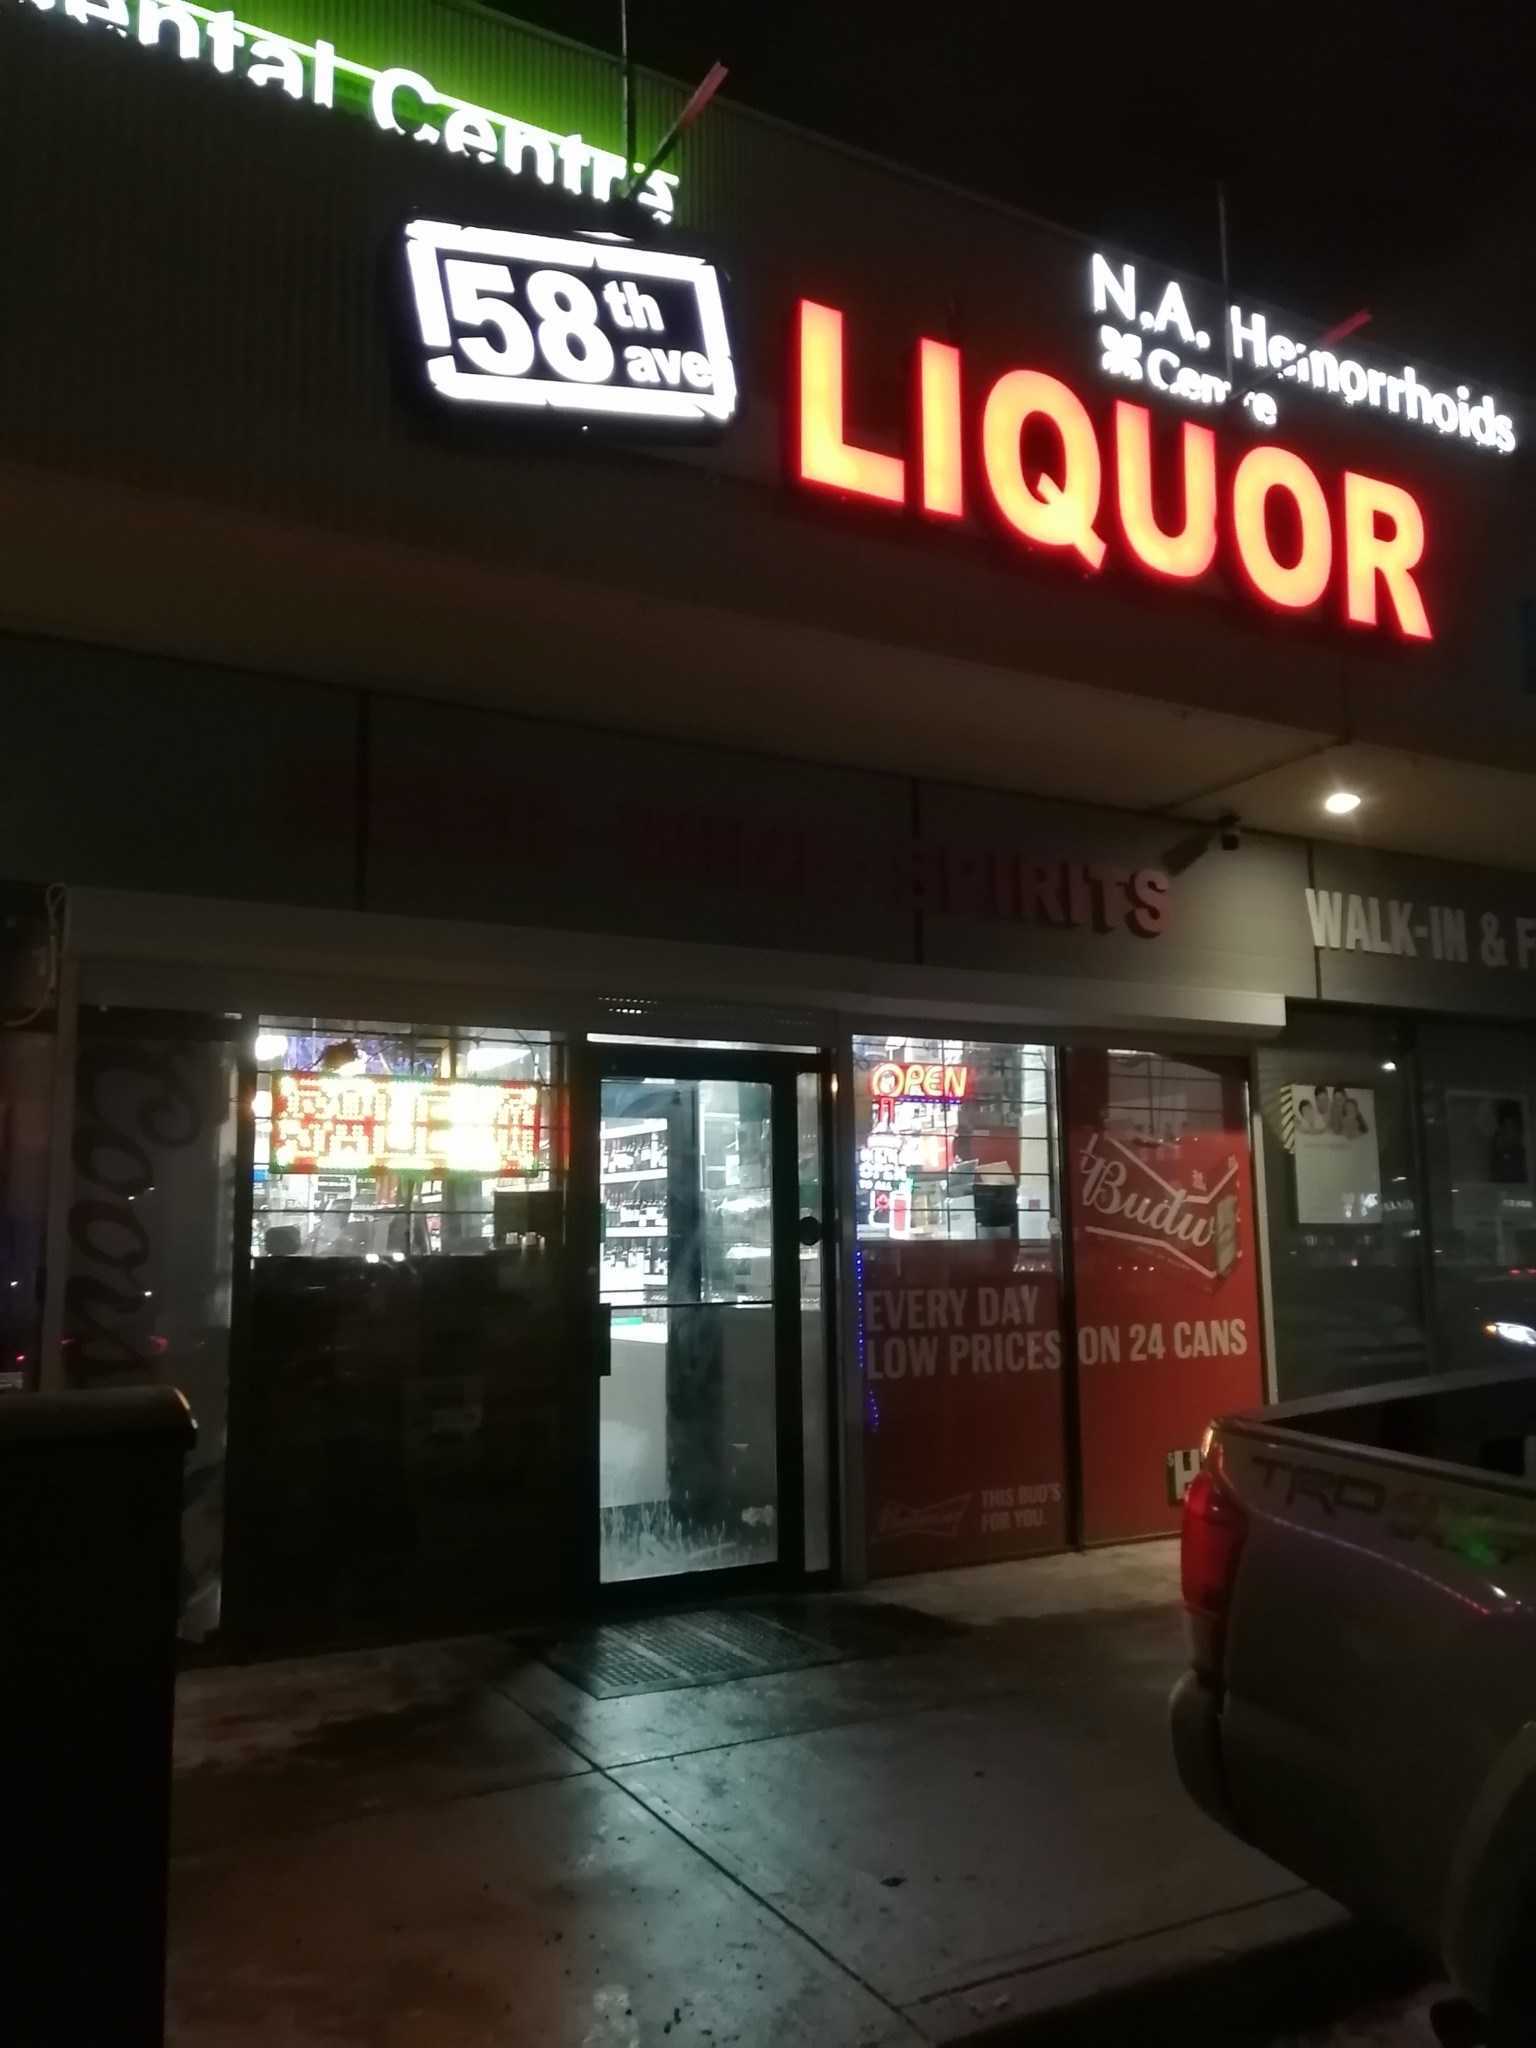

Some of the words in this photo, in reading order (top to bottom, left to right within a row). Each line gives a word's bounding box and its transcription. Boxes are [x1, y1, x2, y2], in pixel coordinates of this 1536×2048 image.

[18, 0, 334, 108] ental
[624, 345, 713, 388] ave
[1092, 252, 1211, 350] N.A.
[1229, 304, 1517, 453] Hemorrhoids
[1147, 347, 1279, 426] Cene
[799, 298, 1434, 640] LIQUOR
[1304, 887, 1469, 964] WALK-IN
[1481, 912, 1509, 967] &
[870, 1063, 968, 1097] OPEN
[865, 1288, 968, 1332] EVERY
[977, 1284, 1039, 1327] DAY
[867, 1335, 938, 1380] LOW
[950, 1330, 1061, 1375] PRICES
[1077, 1325, 1121, 1366] ON
[1129, 1322, 1166, 1362] 24
[1173, 1318, 1248, 1360] CANS
[1252, 1455, 1388, 1518] TRD
